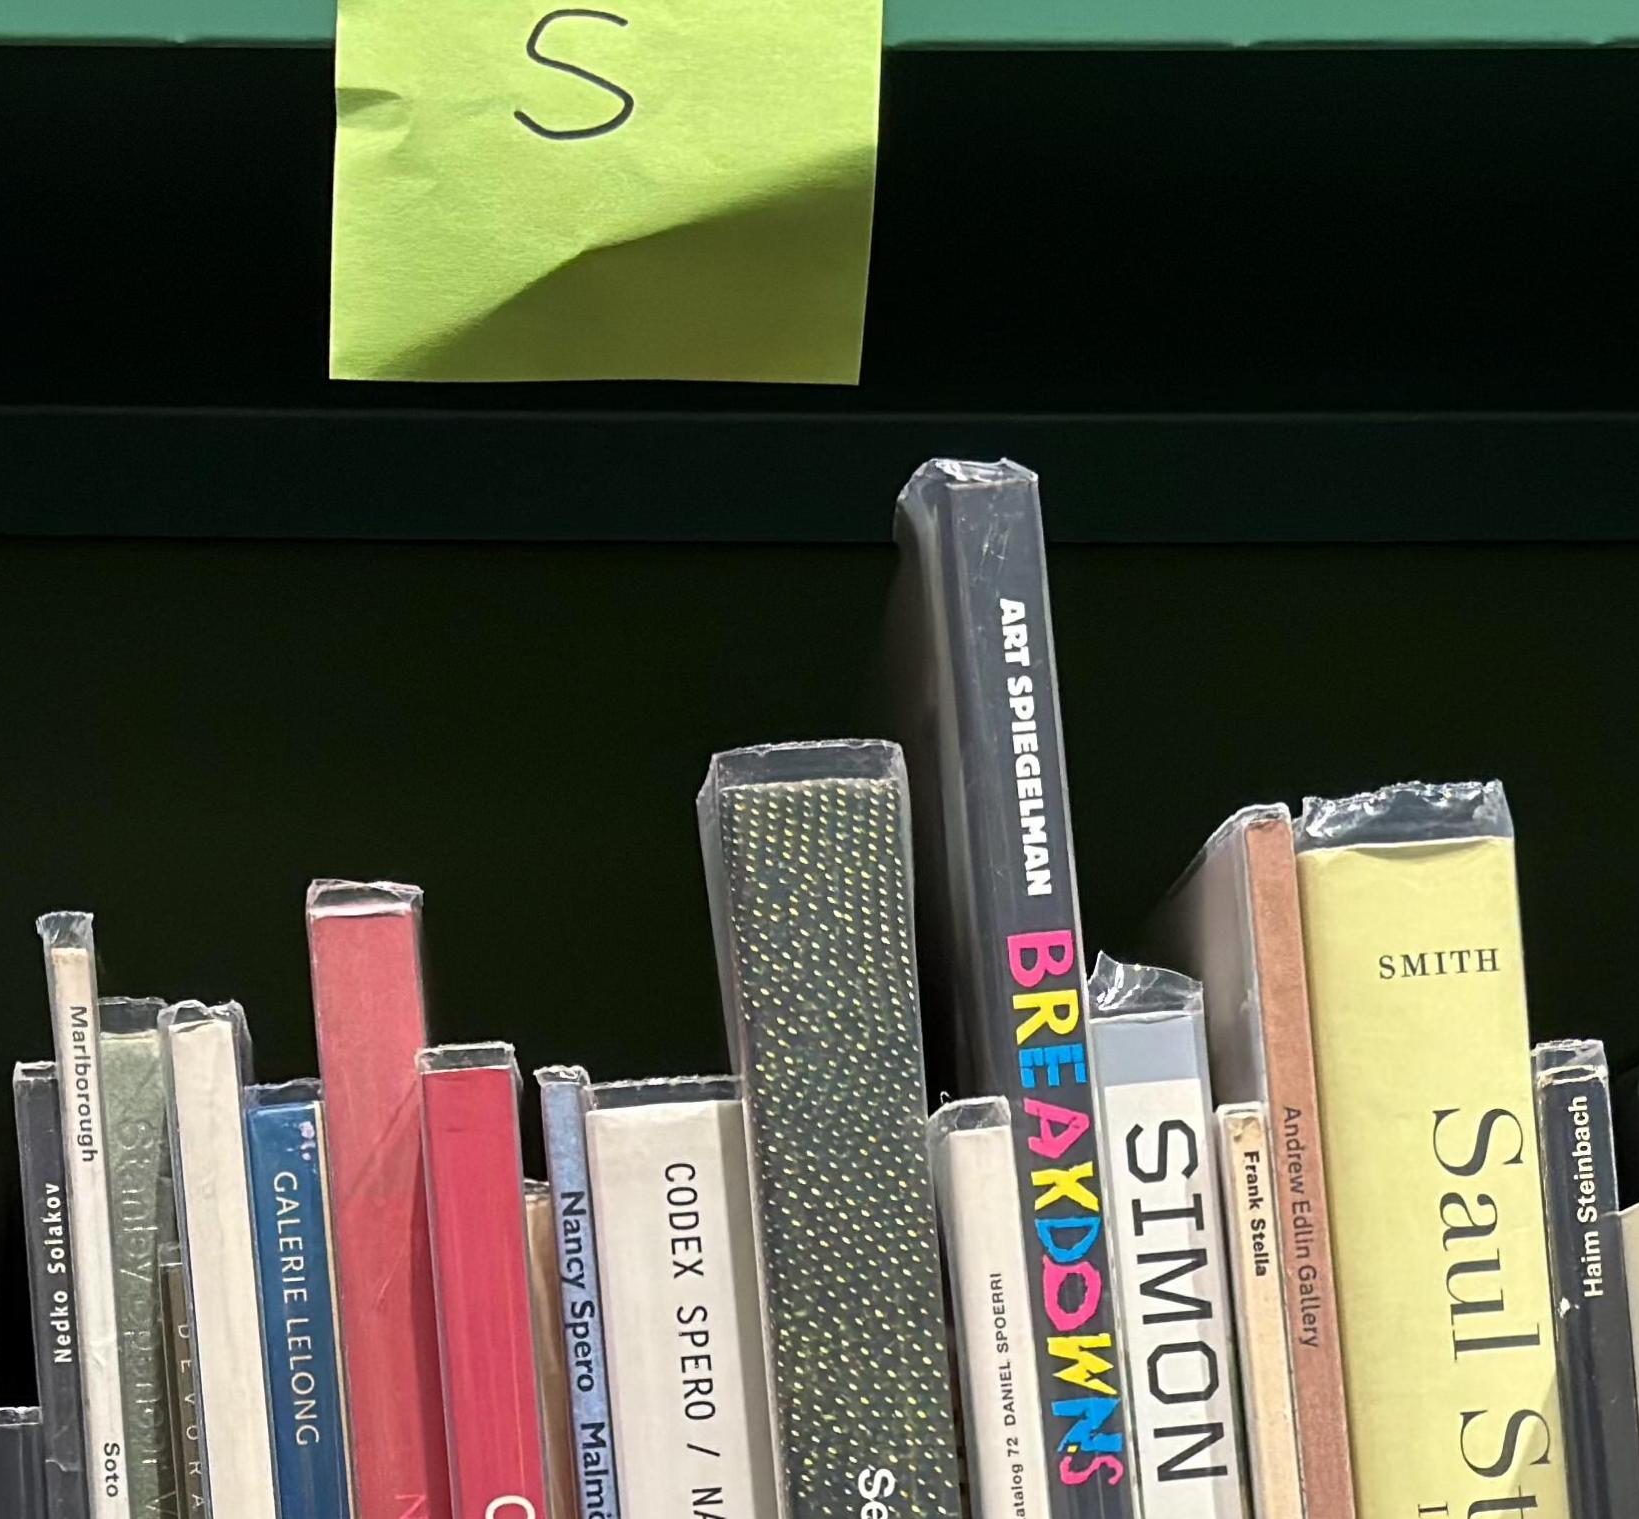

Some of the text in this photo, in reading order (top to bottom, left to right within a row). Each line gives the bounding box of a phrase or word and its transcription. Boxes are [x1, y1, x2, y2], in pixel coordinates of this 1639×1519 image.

[514, 9, 634, 140] S
[1000, 599, 1051, 895] ART SPIEGELMAN
[1379, 947, 1500, 980] SMITH
[70, 1007, 98, 1161] Marlborough
[43, 1184, 72, 1362] Nedko Solakov
[560, 1192, 586, 1292] Nancy
[665, 1163, 704, 1278] CODEX
[1006, 929, 1124, 1487] BREAKDOWNS
[1244, 1151, 1269, 1276] Frank Stella
[1284, 1107, 1320, 1347] Andrew Edlin Gallery
[1432, 1106, 1541, 1361] Saul
[1570, 1096, 1603, 1296] Haim Steinbach
[274, 1172, 319, 1445] GALERIE LELONG
[563, 1299, 597, 1392] Spero
[677, 1306, 715, 1420] SPERO
[1126, 1120, 1228, 1481] SIMON
[104, 1443, 120, 1497] Soto
